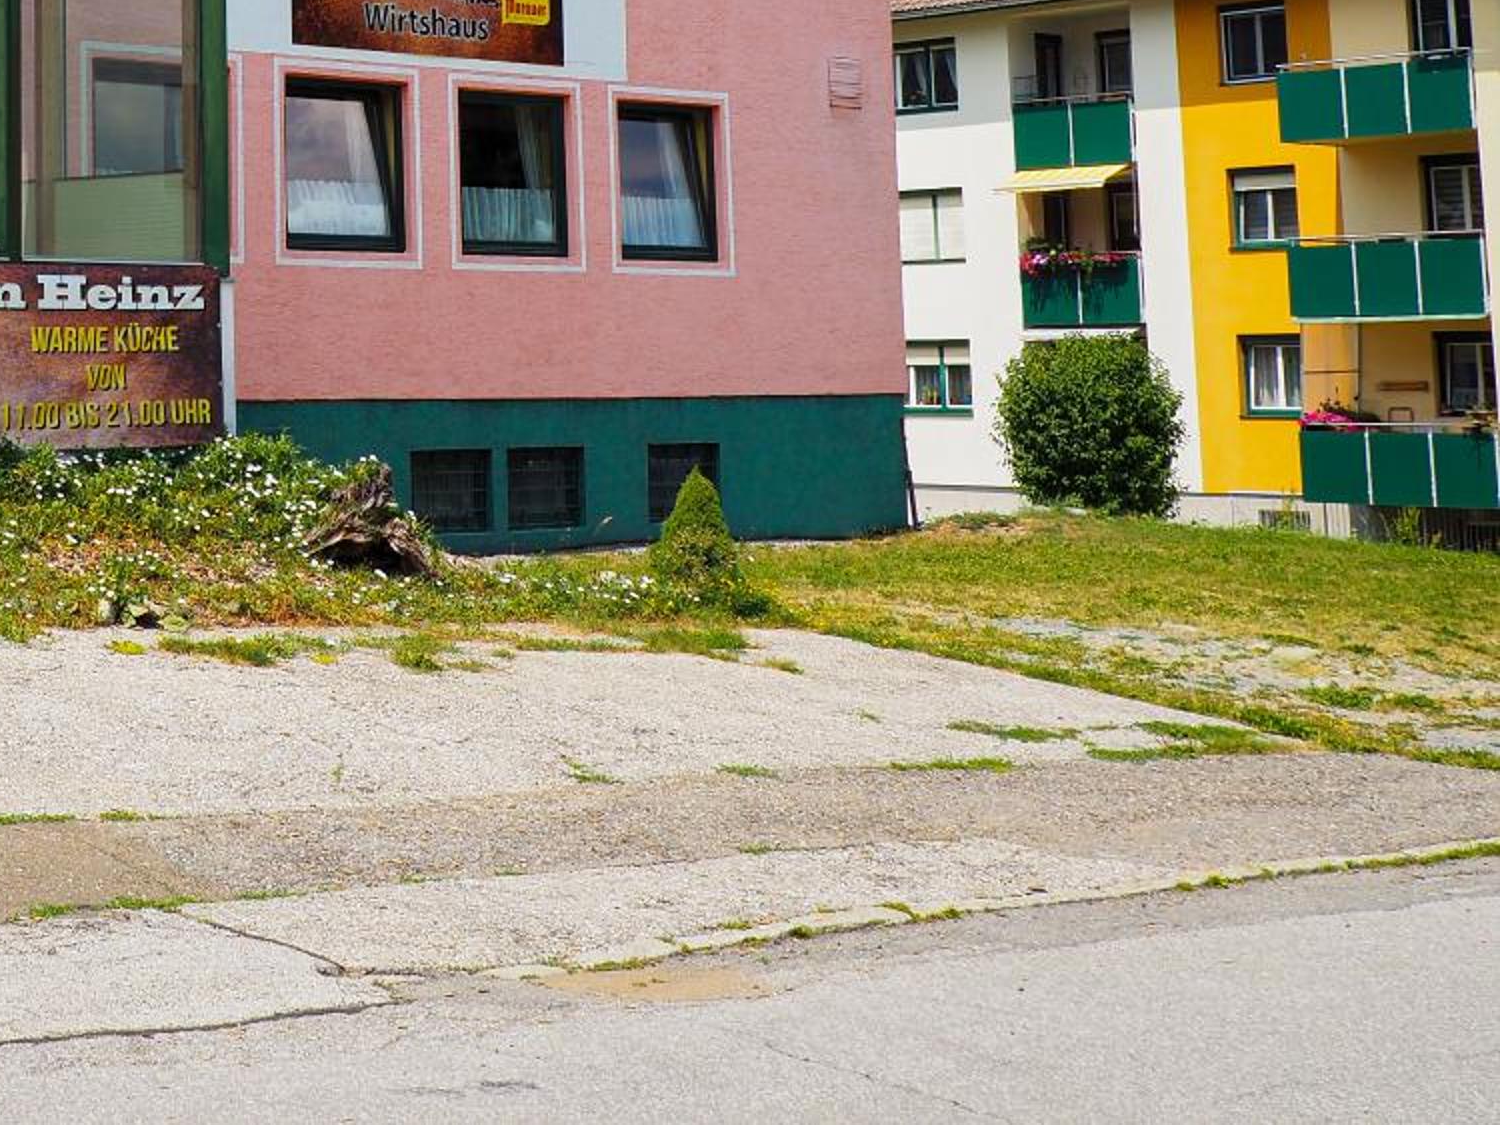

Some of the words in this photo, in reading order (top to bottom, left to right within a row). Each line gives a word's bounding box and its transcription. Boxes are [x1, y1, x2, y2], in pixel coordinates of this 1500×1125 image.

[364, 3, 490, 41] Wirtshaus
[37, 274, 205, 311] Heinz
[31, 325, 109, 353] WARME
[114, 322, 180, 353] KÜCHE
[85, 364, 127, 392] VON
[2, 401, 61, 431] 11.00
[65, 401, 101, 429] BIS
[105, 399, 166, 428] 21.00
[170, 398, 212, 426] UHR
